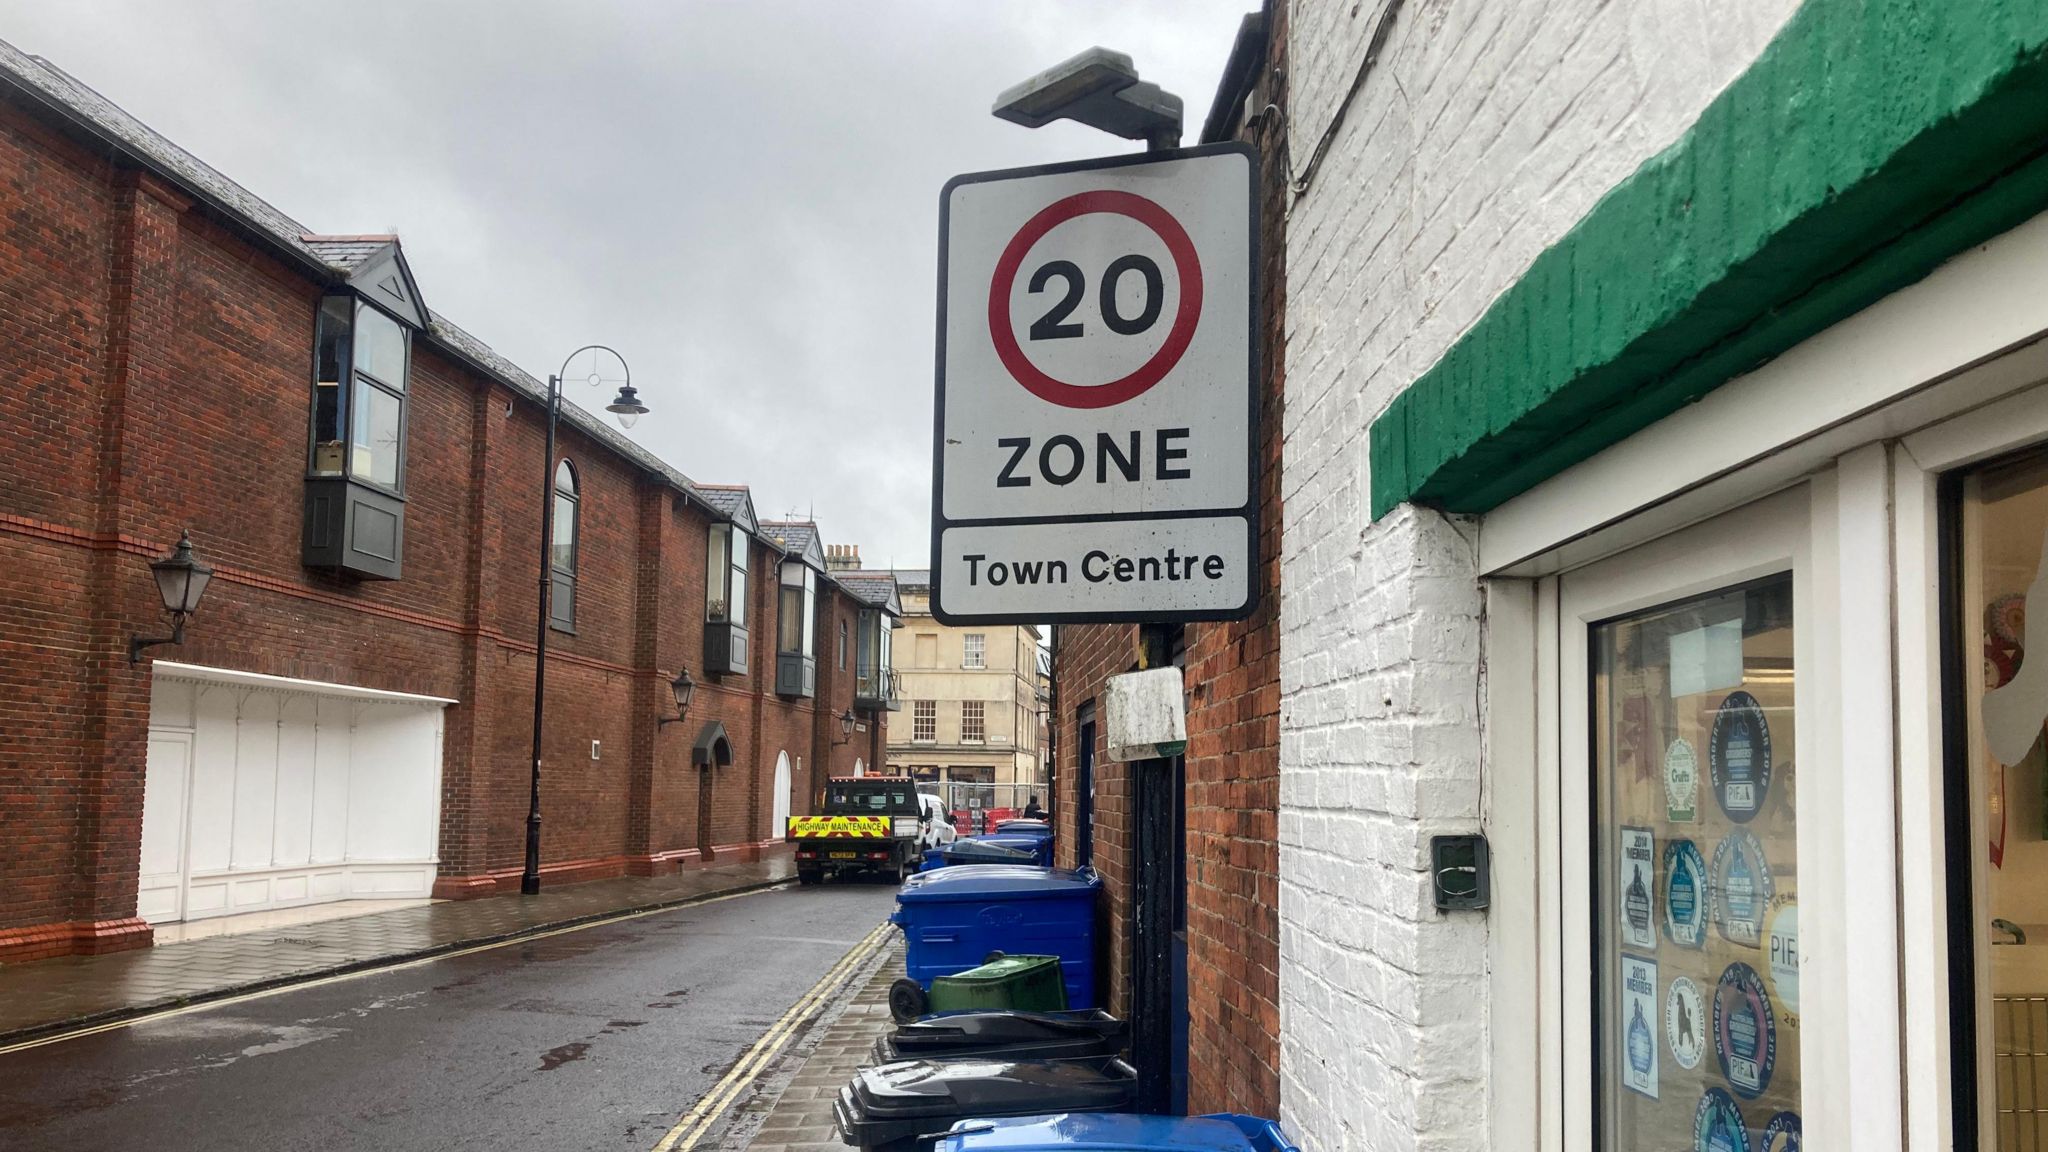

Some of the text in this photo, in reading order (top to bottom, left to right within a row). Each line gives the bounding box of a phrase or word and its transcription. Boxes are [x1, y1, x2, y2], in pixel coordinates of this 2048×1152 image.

[1028, 254, 1164, 341] 20
[997, 428, 1191, 488] ZONE
[963, 549, 1225, 586] Town Centre
[797, 822, 882, 832] HIGHWAY MAINTENANCE
[1626, 977, 1652, 997] MEMBER
[1632, 966, 1647, 981] 2013
[1749, 972, 1775, 1030] MEMBER
[1729, 1102, 1751, 1152] MEMBE
